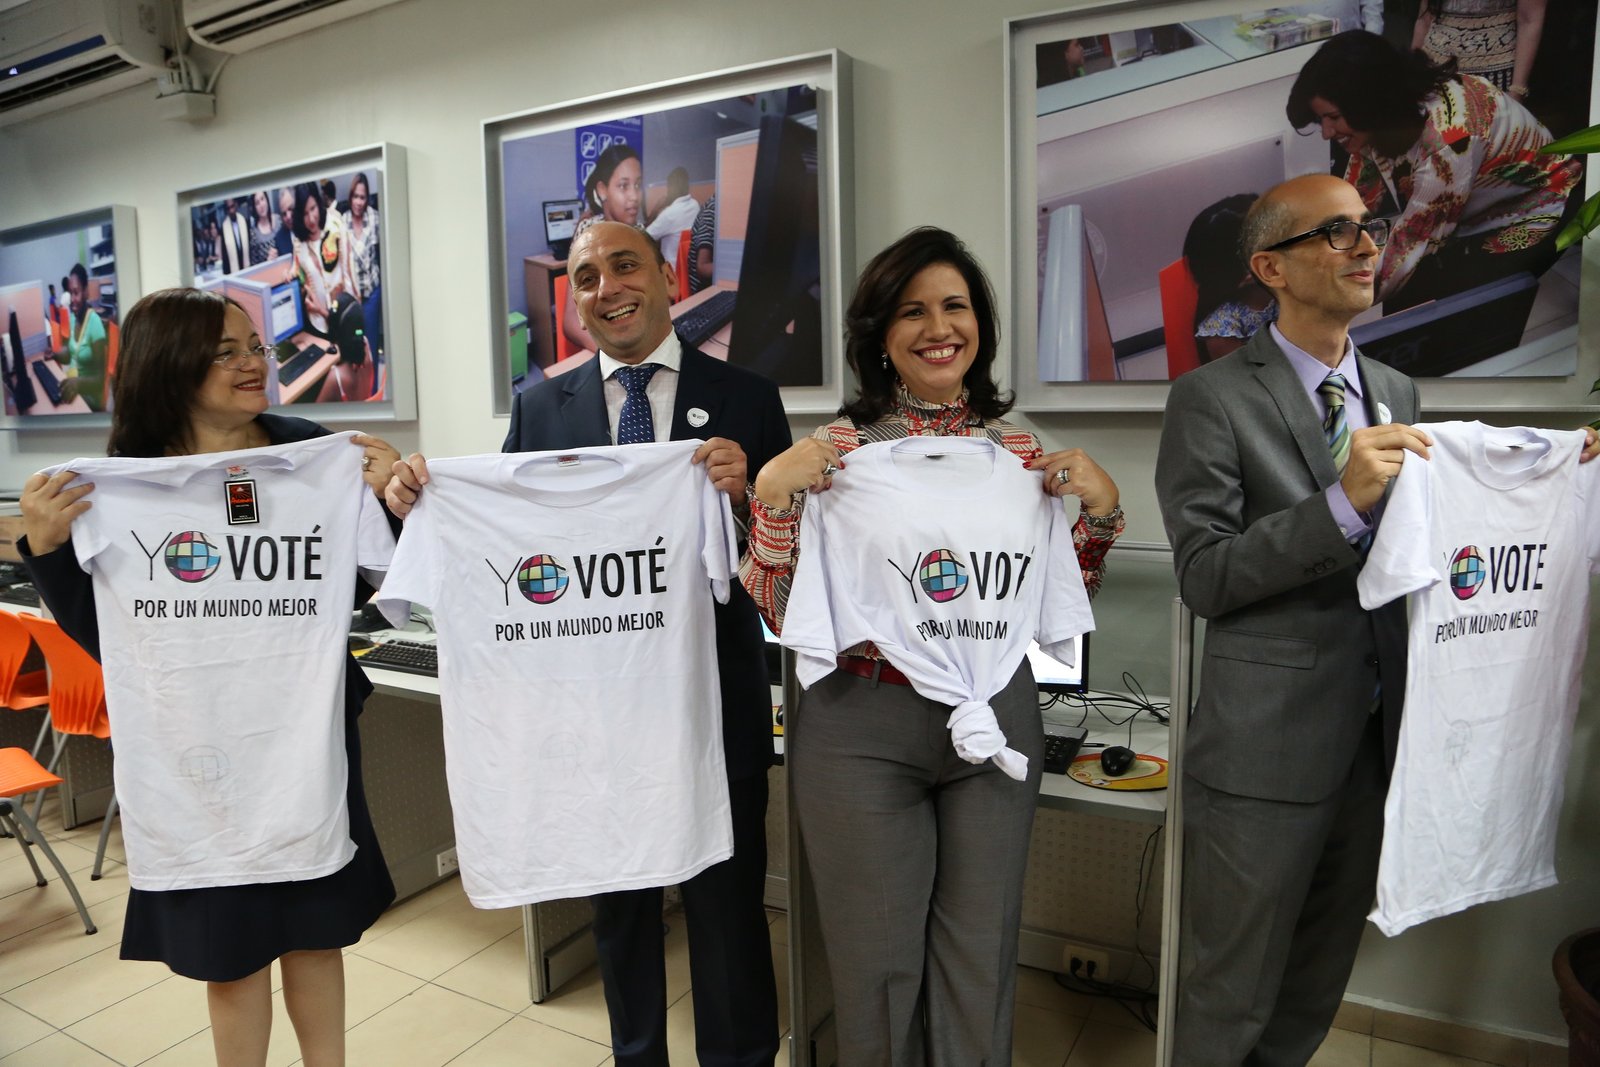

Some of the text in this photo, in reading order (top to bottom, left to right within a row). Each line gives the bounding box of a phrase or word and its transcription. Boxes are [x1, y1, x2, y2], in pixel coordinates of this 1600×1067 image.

[226, 525, 322, 581] VOTÉ
[573, 536, 667, 599] VOTÉ
[134, 598, 317, 618] POR UN MUNDO MEJOR
[495, 610, 665, 641] POR UN MUNDO MEJOR
[916, 619, 942, 641] POR
[1435, 621, 1454, 643] POR
[1468, 613, 1507, 635] MUNDO
